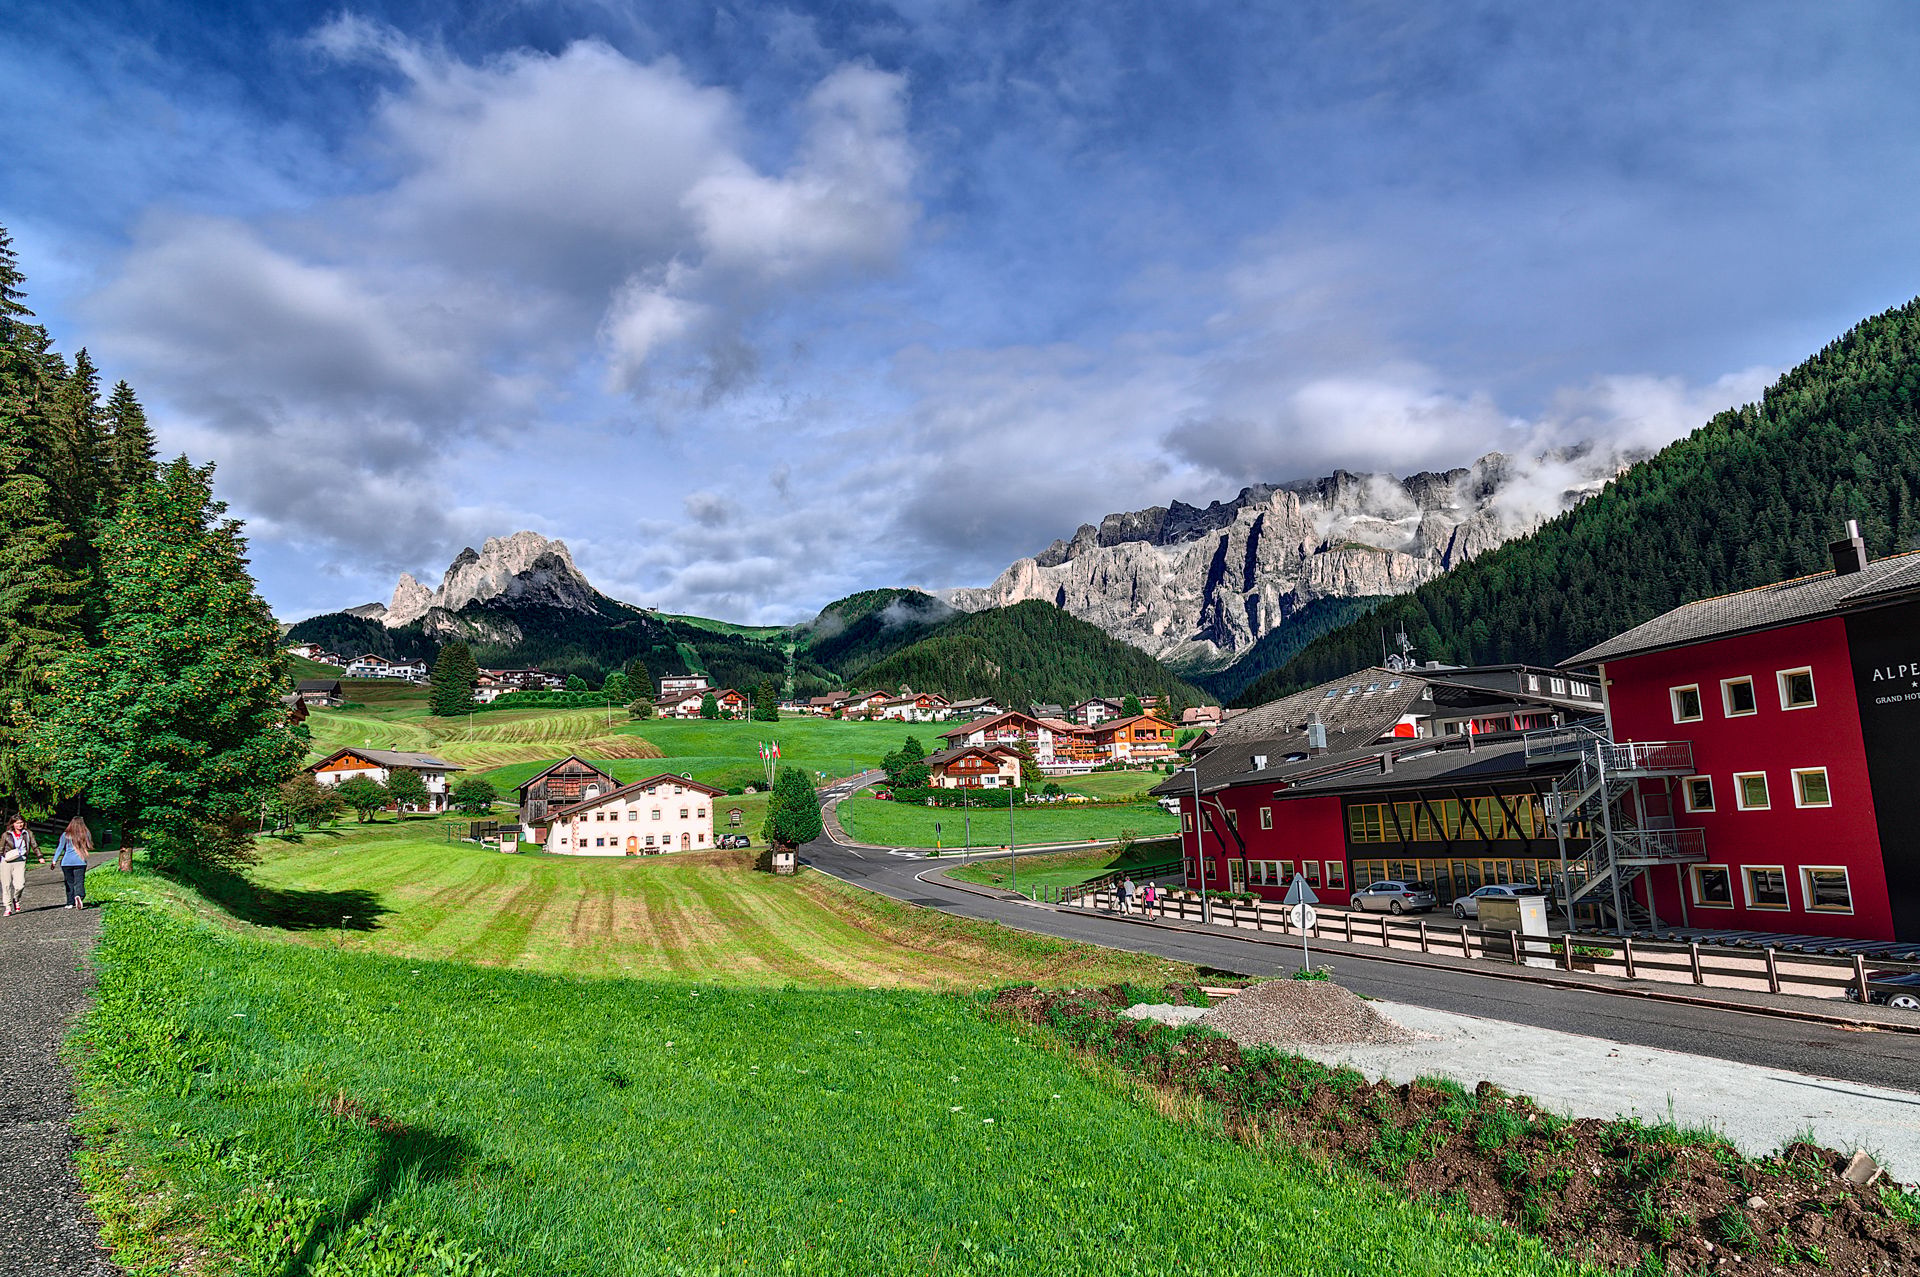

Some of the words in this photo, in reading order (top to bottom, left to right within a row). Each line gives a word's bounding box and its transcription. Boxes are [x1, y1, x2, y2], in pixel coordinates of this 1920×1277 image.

[1872, 663, 1920, 682] ALPE
[1875, 695, 1903, 704] GRAND
[1295, 911, 1313, 923] 30
